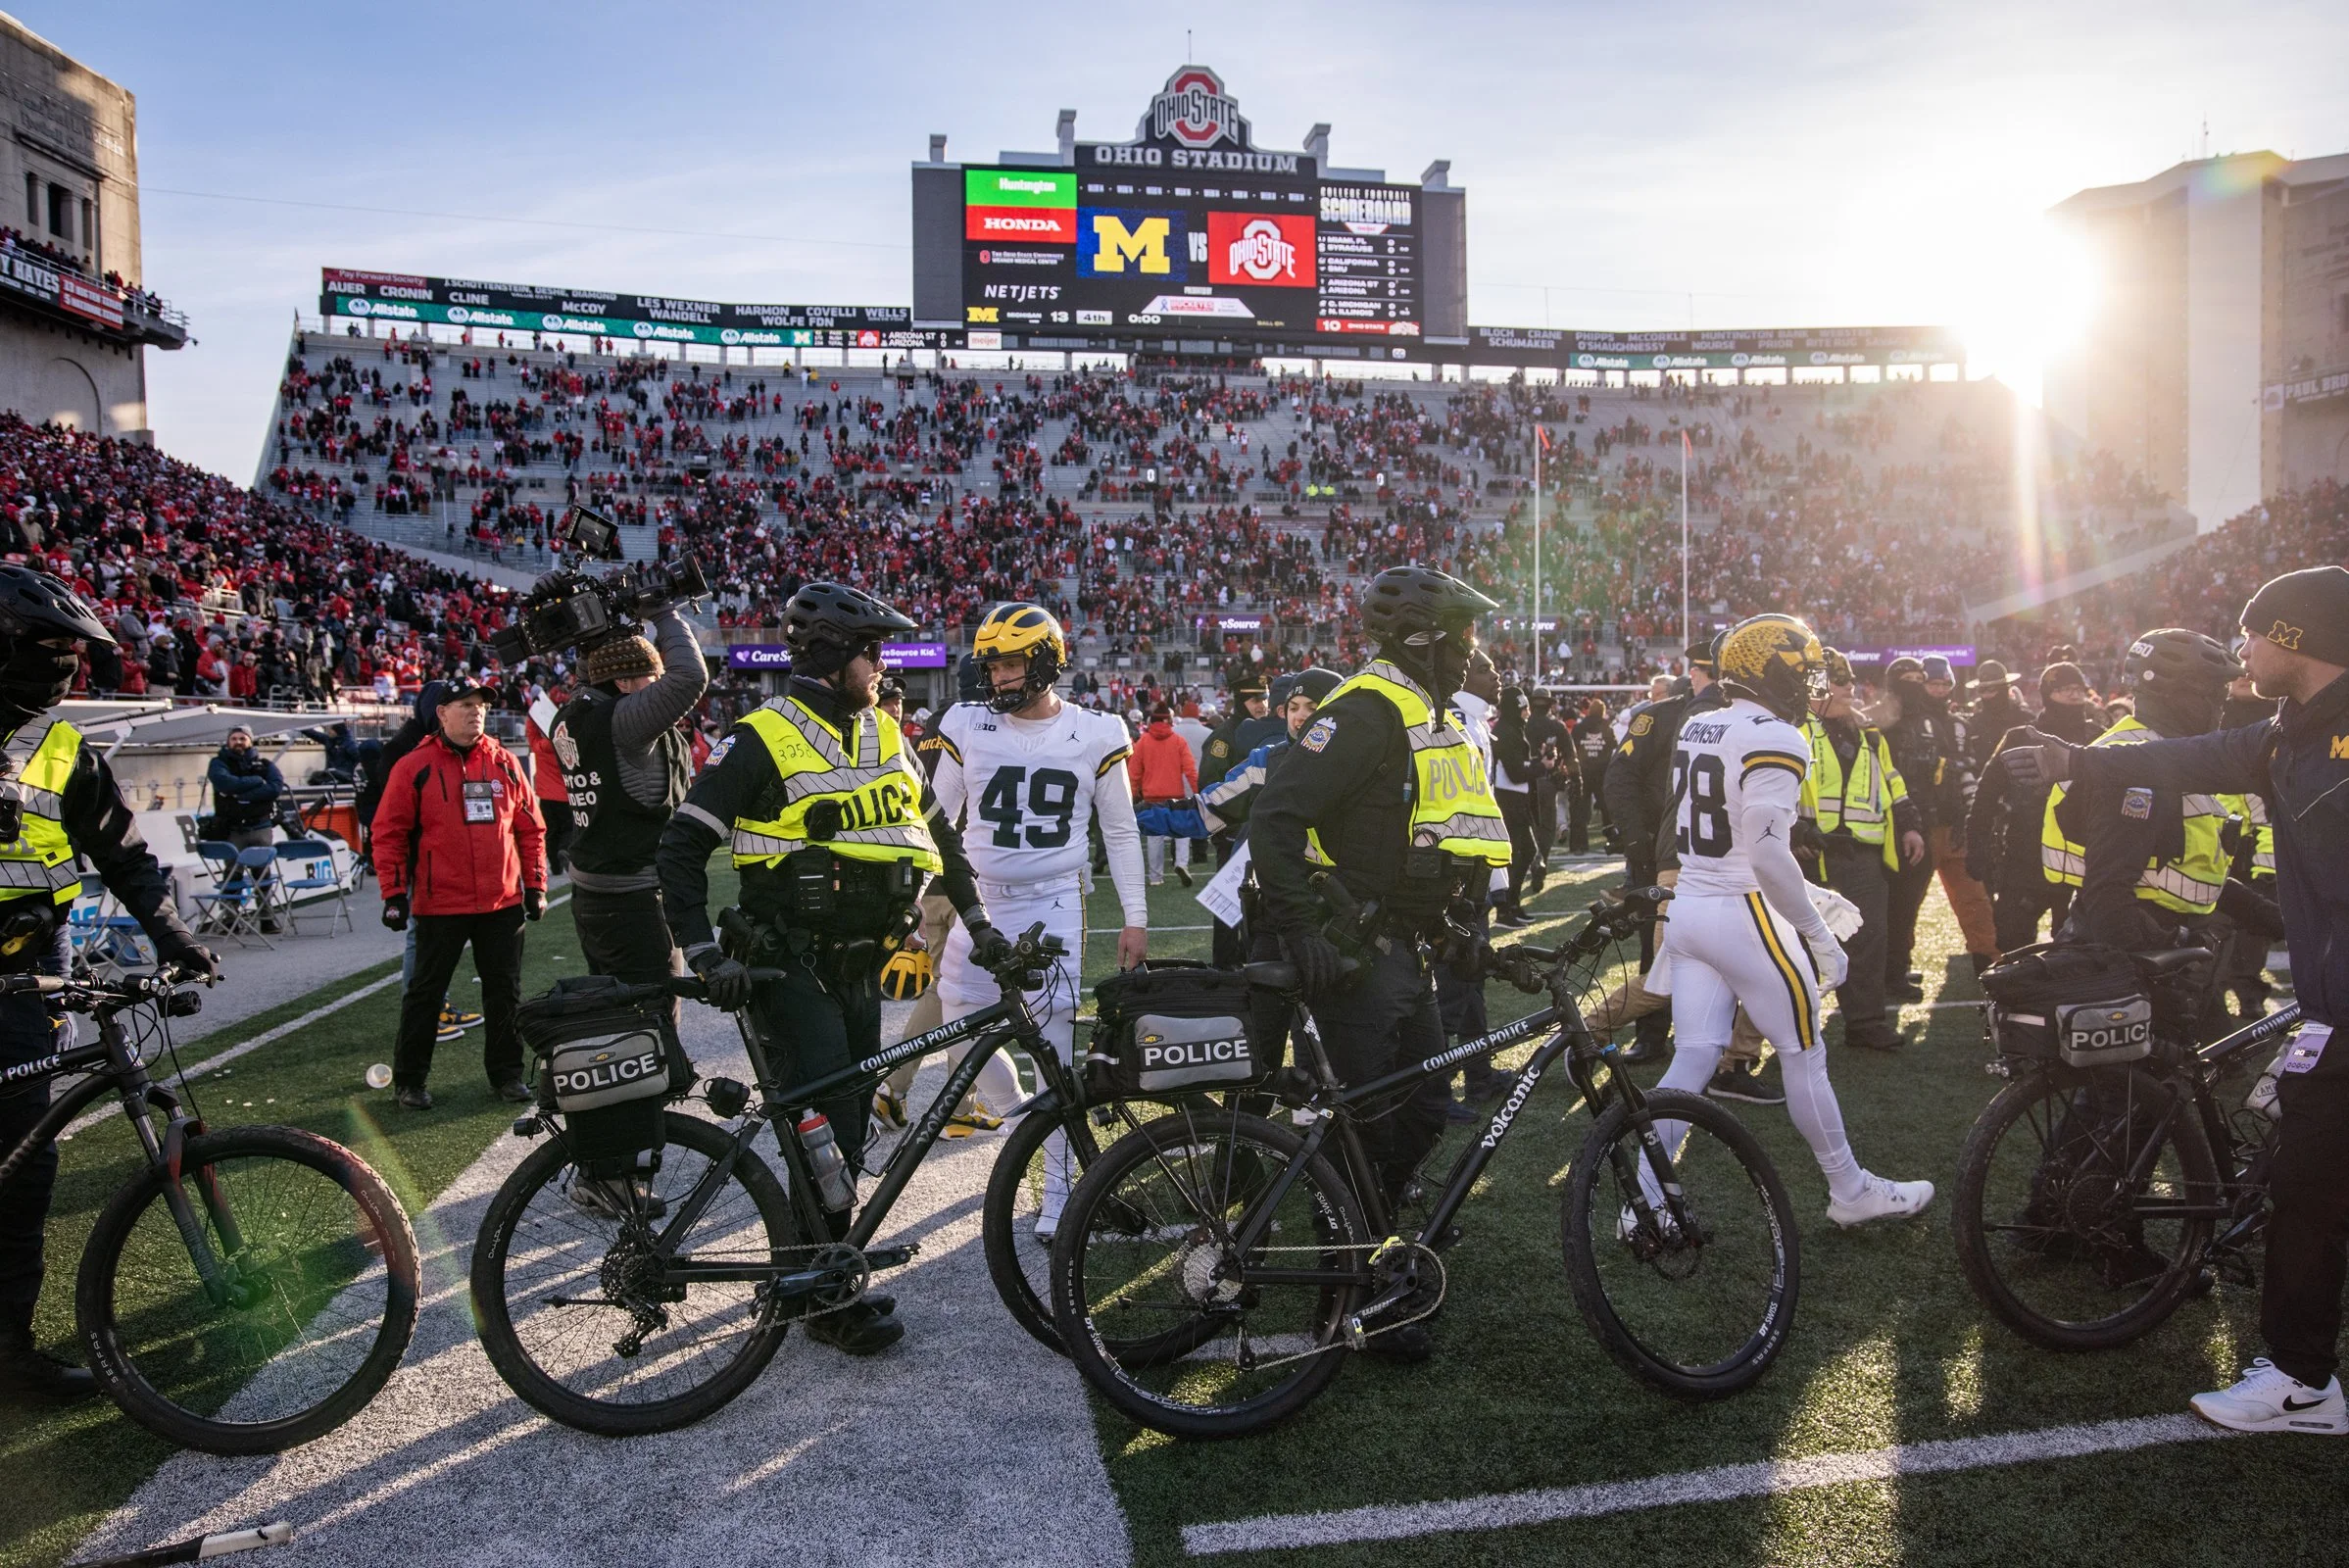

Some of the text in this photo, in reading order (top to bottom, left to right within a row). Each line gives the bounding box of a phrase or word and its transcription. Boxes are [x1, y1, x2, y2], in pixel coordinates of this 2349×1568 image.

[1156, 89, 1237, 141] OHIO STATE
[1095, 146, 1298, 174] OHIO STADIUM
[999, 177, 1056, 194] Huntington
[1320, 186, 1360, 198] COLLEGE
[1365, 189, 1410, 201] FOOTBALL
[1320, 197, 1411, 225] SCOREBOARD
[984, 218, 1061, 231] HONDA
[1094, 215, 1208, 273] M VS
[1229, 233, 1296, 278] OHIO STATE
[1327, 258, 1379, 267] CALIFORNIA
[13, 258, 60, 294] HAYES
[339, 270, 424, 285] Pay Forward Society
[327, 280, 433, 301] AUER CRONIN
[572, 290, 617, 301] DIAMOND
[984, 284, 1060, 303] NETJETS
[369, 302, 417, 318] Allstate
[449, 292, 607, 315] CLINE McCOY
[637, 297, 721, 315] LES WEXNER
[735, 305, 907, 318] HARMON COVELLI WELLS
[468, 312, 514, 324] Allstate
[650, 308, 712, 323] WANDELL
[761, 317, 834, 327] WOLFE FDN
[967, 307, 1000, 322] M
[1051, 311, 1069, 322] 13
[1128, 314, 1161, 323] 0:00
[563, 319, 607, 333] Allstate
[653, 326, 694, 340] Allstate
[1323, 320, 1342, 331] 10
[1480, 327, 1515, 338] BLOCH
[1528, 329, 1563, 340] CRANE
[1575, 331, 1615, 342] PHIPPS
[1628, 331, 1688, 342] McCORKLE
[1701, 331, 1774, 340] HUNTINGTON
[1778, 329, 1809, 339] BANK
[740, 331, 781, 344] Allstate
[971, 336, 998, 347] meijer
[1489, 337, 1555, 350] SCHUMAKER
[1578, 340, 1666, 352] O'SHAUGHNESSY
[1691, 340, 1736, 350] NOURSE
[1758, 340, 1793, 350] PRIOR
[1594, 357, 1630, 368] Allstate
[1670, 356, 1708, 367] Allstate
[1749, 355, 1786, 365] Allstate
[1828, 353, 1865, 364] Allstate
[2285, 379, 2320, 400] PAUL
[2267, 619, 2303, 650] M
[590, 771, 602, 786] &
[1428, 752, 1486, 802] POLIC
[840, 780, 912, 831] OLICE
[980, 764, 1079, 850] 49
[1673, 750, 1733, 858] 28
[860, 1018, 969, 1073] COLUMBUS POLICE
[1145, 1039, 1250, 1066] POLICE
[1423, 1020, 1529, 1073] COLUMBUS POLICE
[2293, 1049, 2320, 1057] 2024
[7, 1054, 62, 1080] POLICE
[553, 1053, 658, 1094] POLICE
[916, 1061, 974, 1145] volcanic
[1481, 1063, 1541, 1150] volcanic
[1314, 1191, 1339, 1230] DT SWISS
[1758, 1322, 1769, 1338] DT
[1765, 1301, 1779, 1325] SWISS
[1084, 1317, 1108, 1357] DT SWISS
[1751, 1329, 1781, 1366] SERFAS
[90, 1332, 120, 1384] SERFAS
